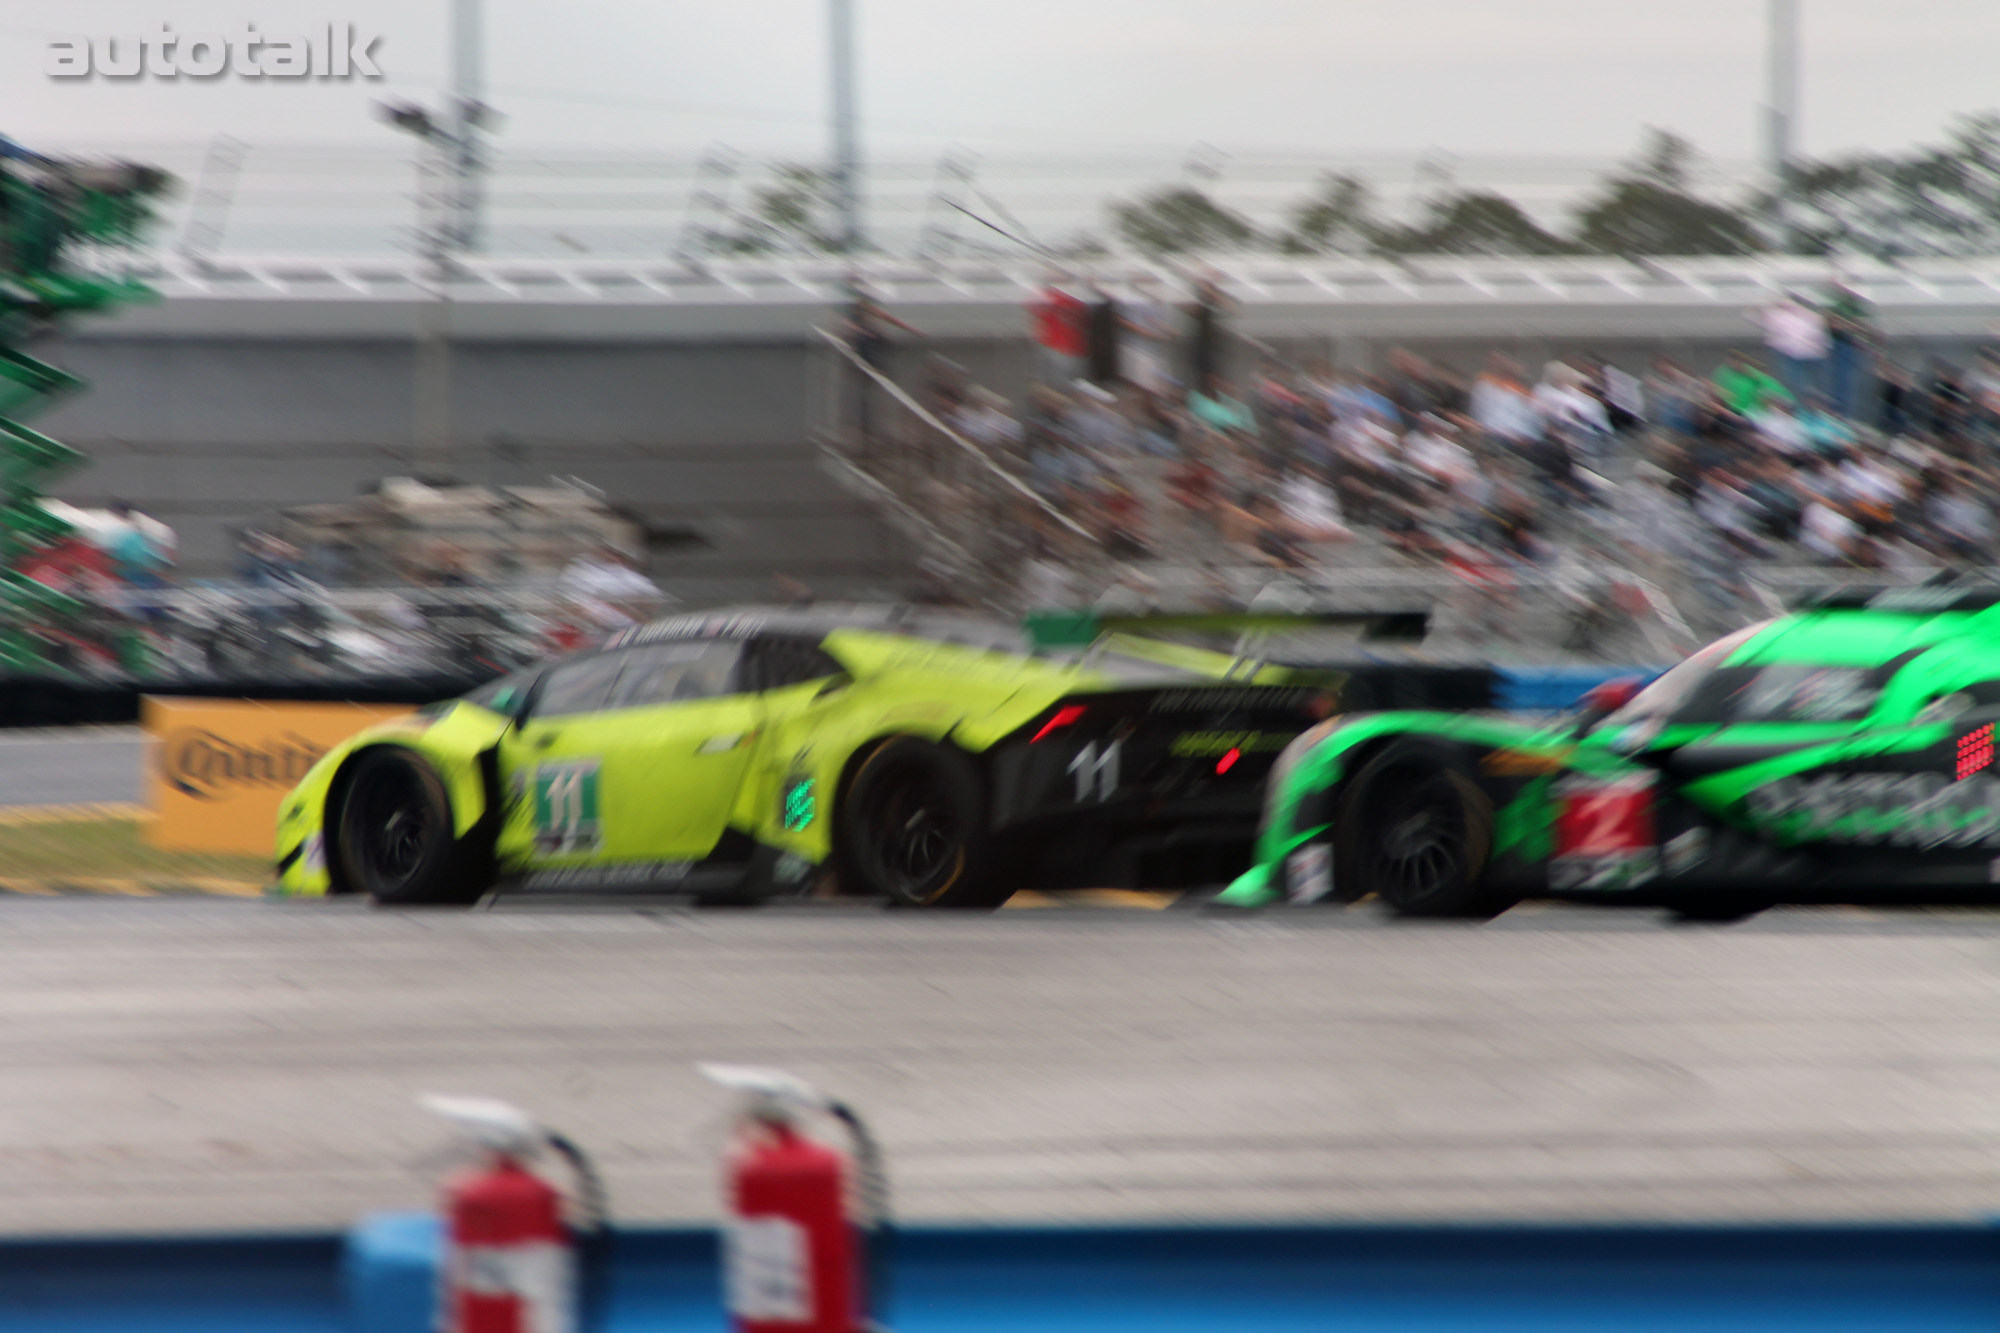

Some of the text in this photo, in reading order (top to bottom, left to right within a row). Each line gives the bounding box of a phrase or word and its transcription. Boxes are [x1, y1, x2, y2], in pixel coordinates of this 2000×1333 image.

[545, 768, 583, 840] 11
[1066, 738, 1121, 803] 11
[1577, 786, 1635, 855] 2
